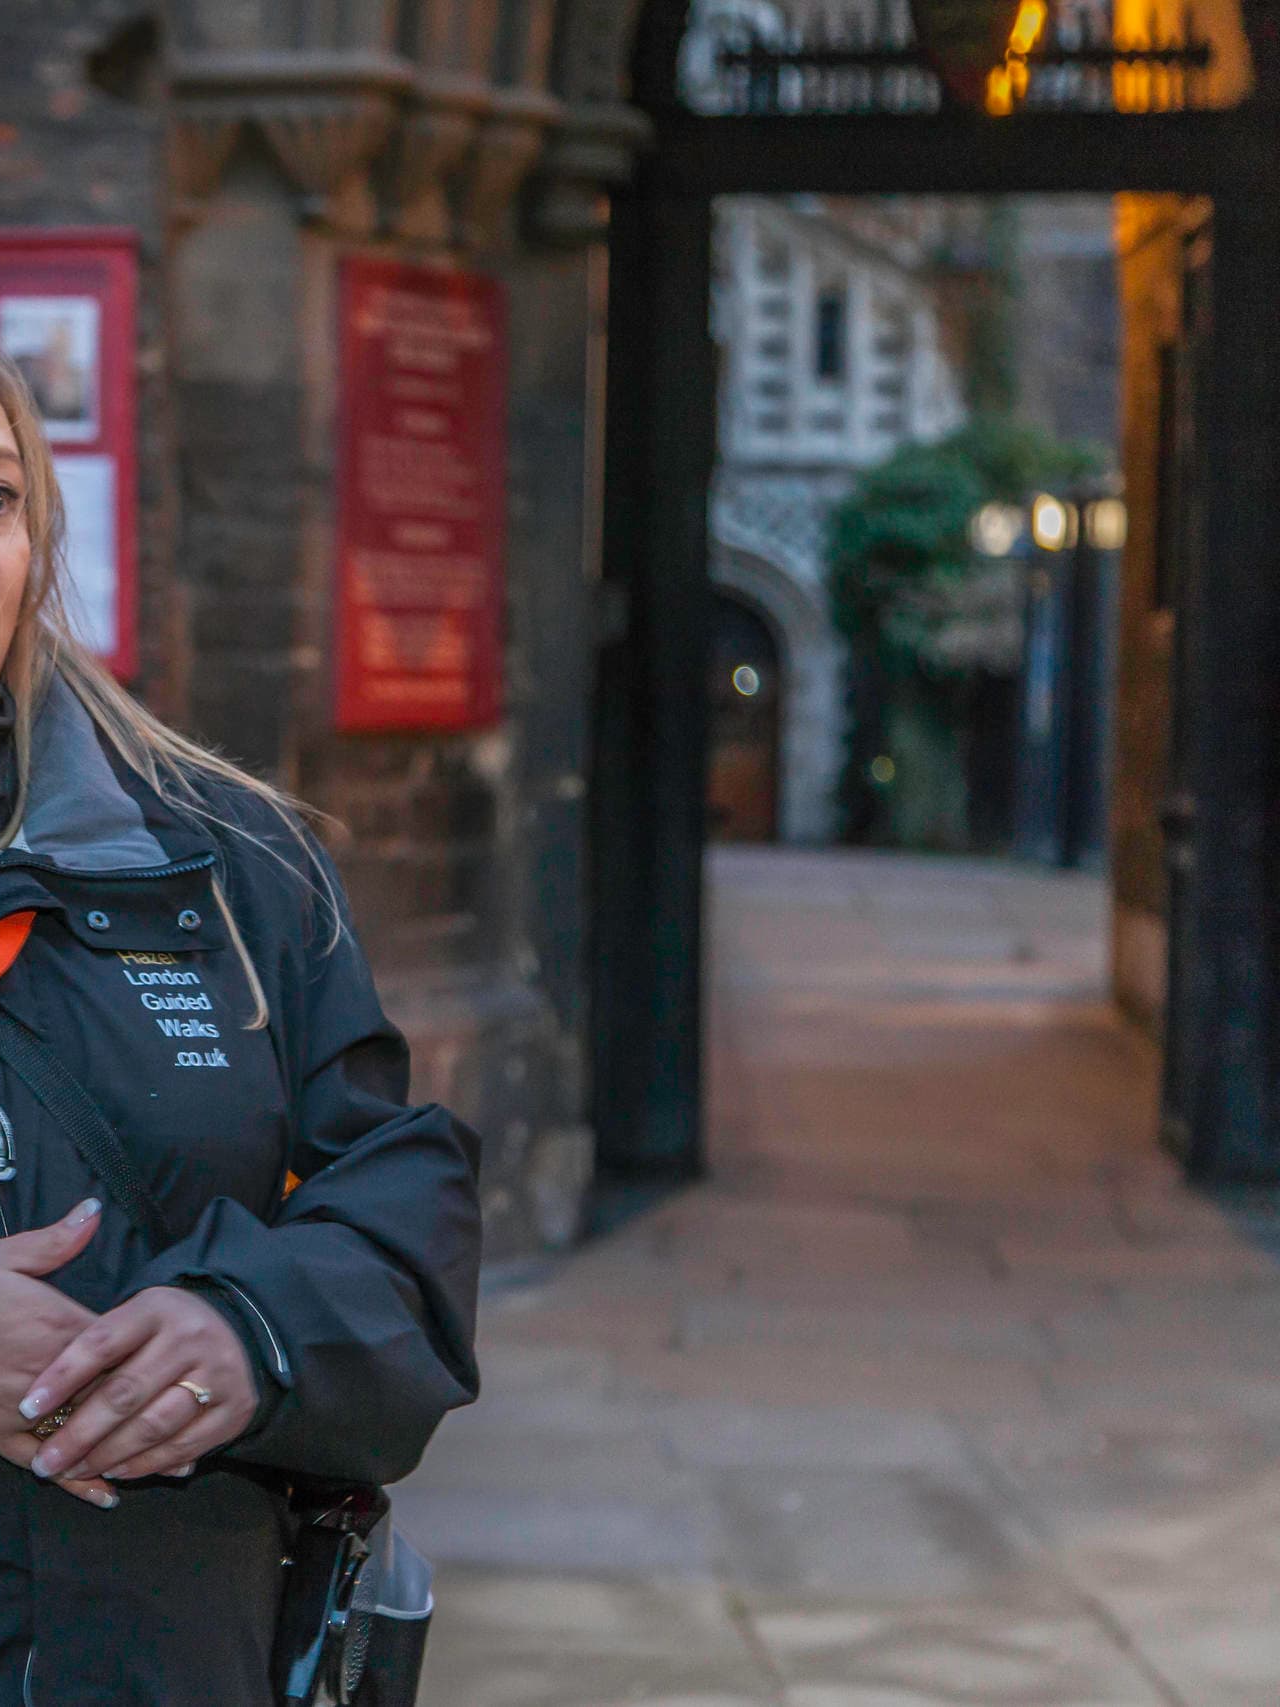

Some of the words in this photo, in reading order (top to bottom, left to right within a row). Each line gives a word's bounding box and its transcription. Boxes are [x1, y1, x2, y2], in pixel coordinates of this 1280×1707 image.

[123, 969, 200, 986] London
[141, 993, 213, 1011] Guided
[156, 1019, 220, 1038] Walks
[174, 1048, 230, 1068] .co.uk
